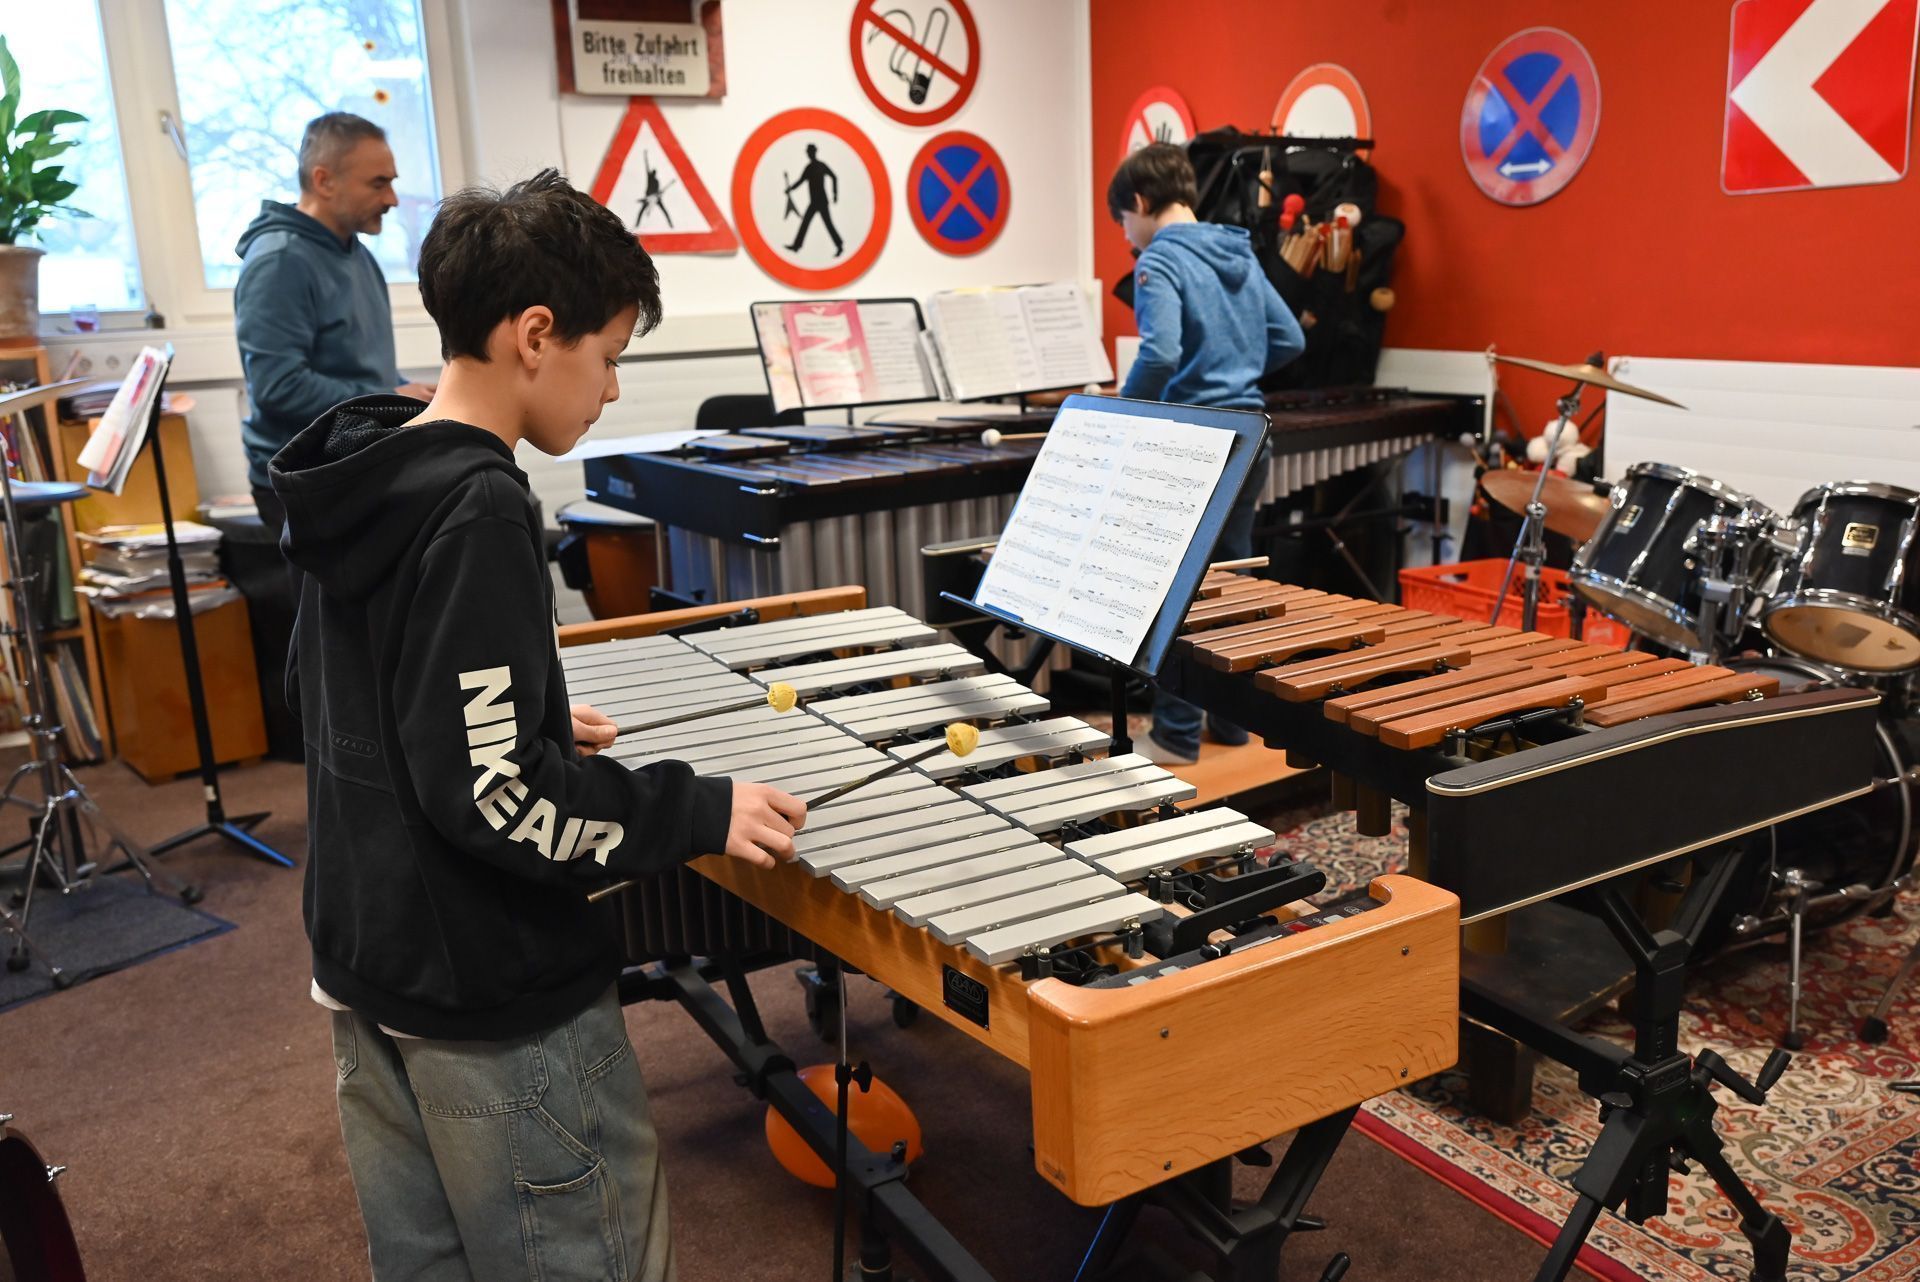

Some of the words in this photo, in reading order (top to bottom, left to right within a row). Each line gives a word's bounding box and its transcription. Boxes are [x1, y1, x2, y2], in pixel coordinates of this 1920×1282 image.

[583, 31, 627, 54] Bitte
[634, 33, 699, 56] Zufahrt
[603, 62, 686, 85] freihalten
[459, 666, 529, 831] NIKE
[508, 797, 625, 866] AIR
